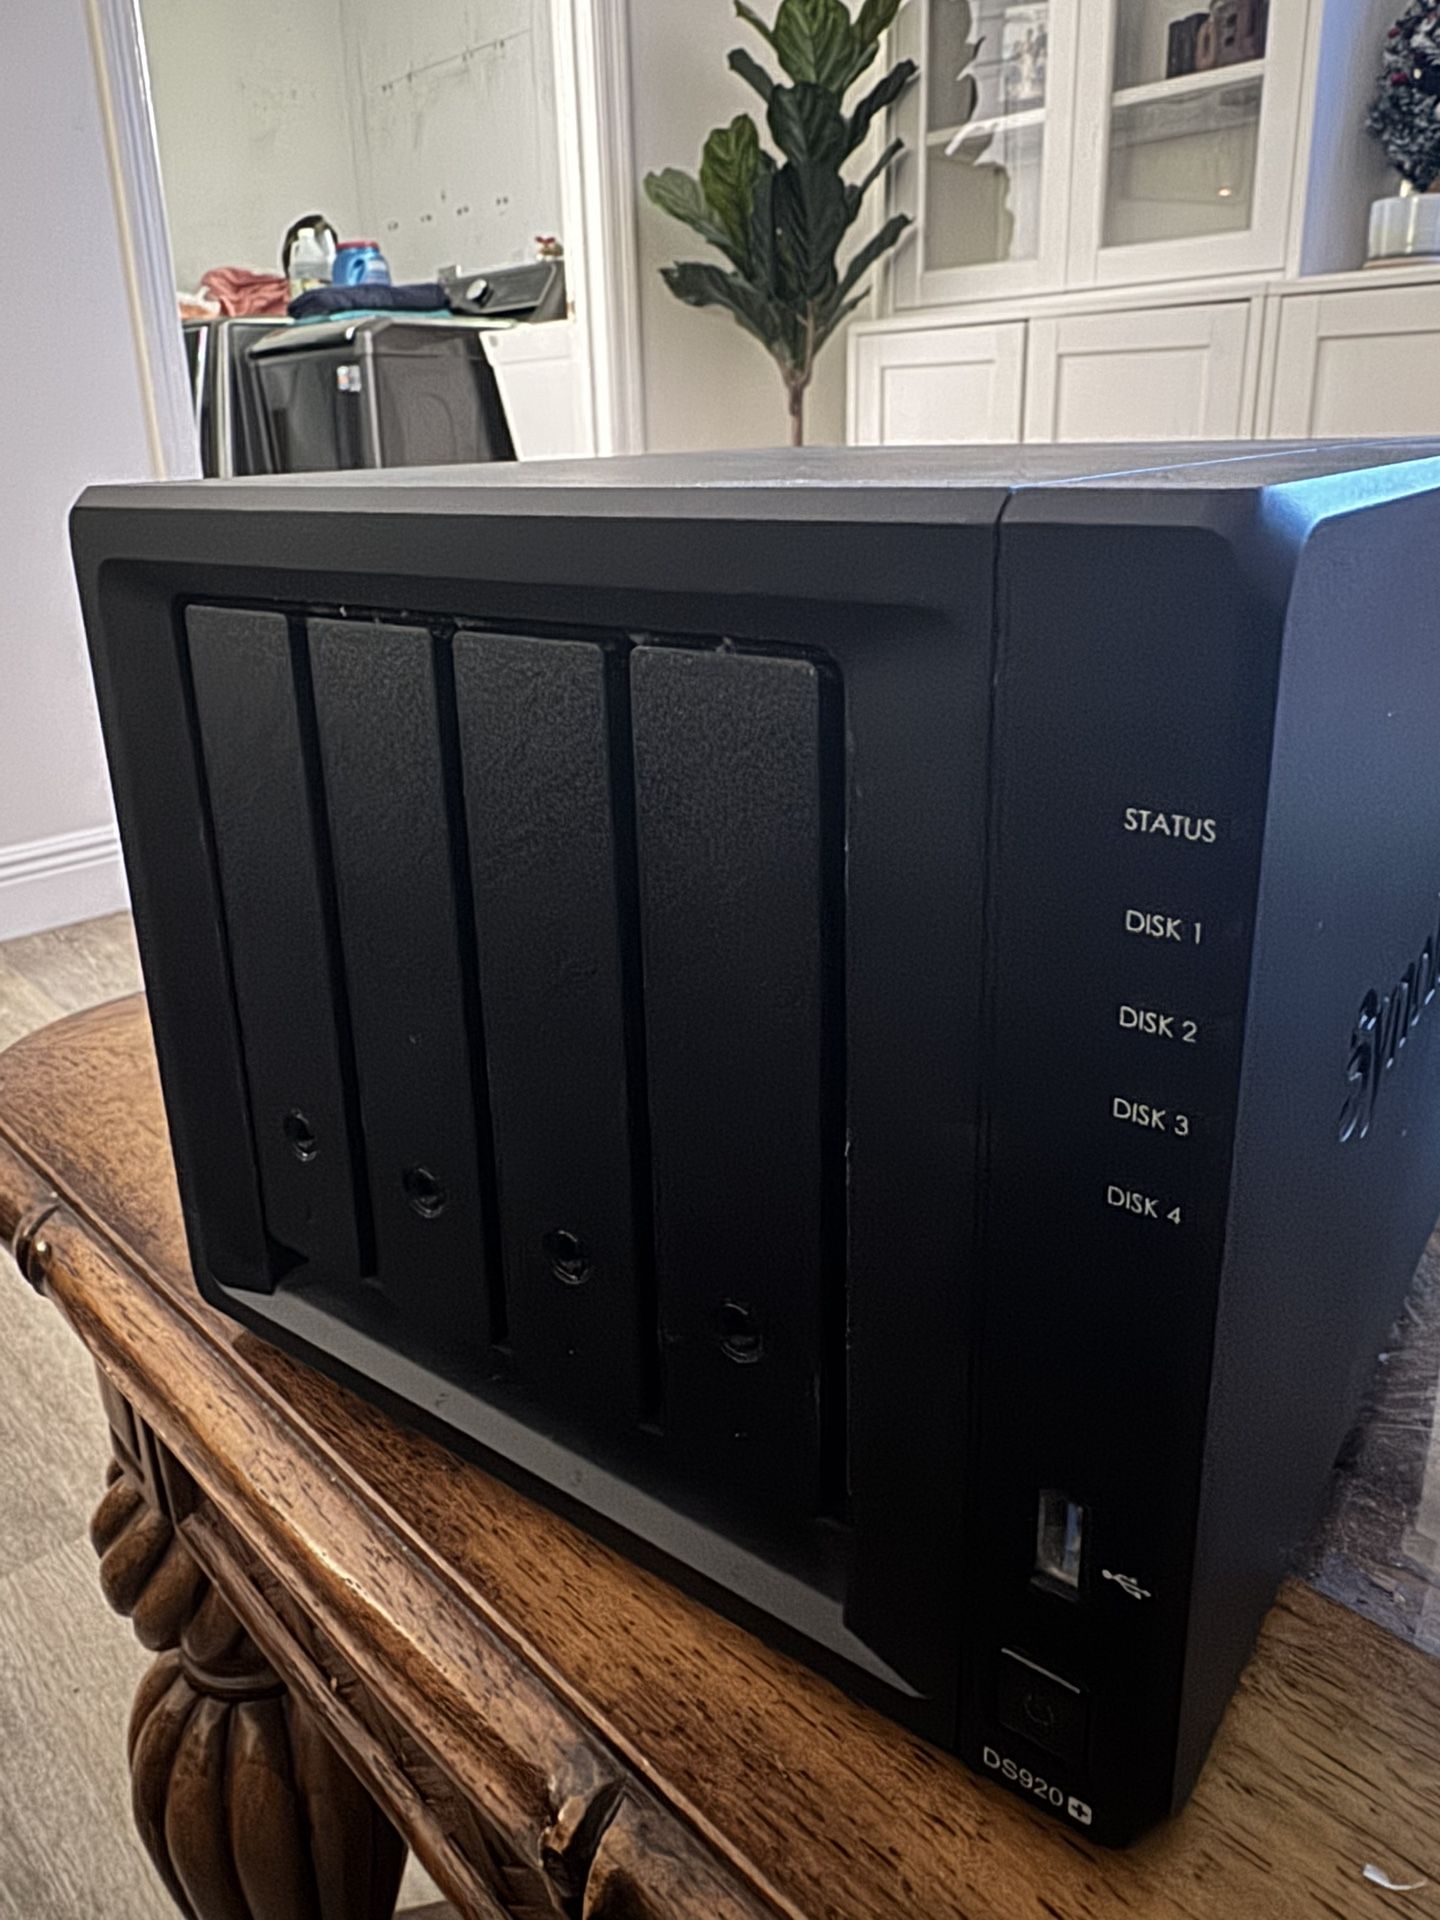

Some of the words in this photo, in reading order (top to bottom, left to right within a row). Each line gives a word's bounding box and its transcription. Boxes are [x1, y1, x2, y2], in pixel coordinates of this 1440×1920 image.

[1123, 807, 1216, 843] STATUS
[1125, 908, 1181, 941] DISK
[1193, 921, 1202, 944] 1
[1118, 1004, 1174, 1038] DISK
[1181, 1020, 1198, 1043] 2
[1112, 1097, 1167, 1131] DISK
[1173, 1114, 1189, 1136] 3
[1107, 1184, 1159, 1219] DISK
[1166, 1206, 1181, 1225] 4
